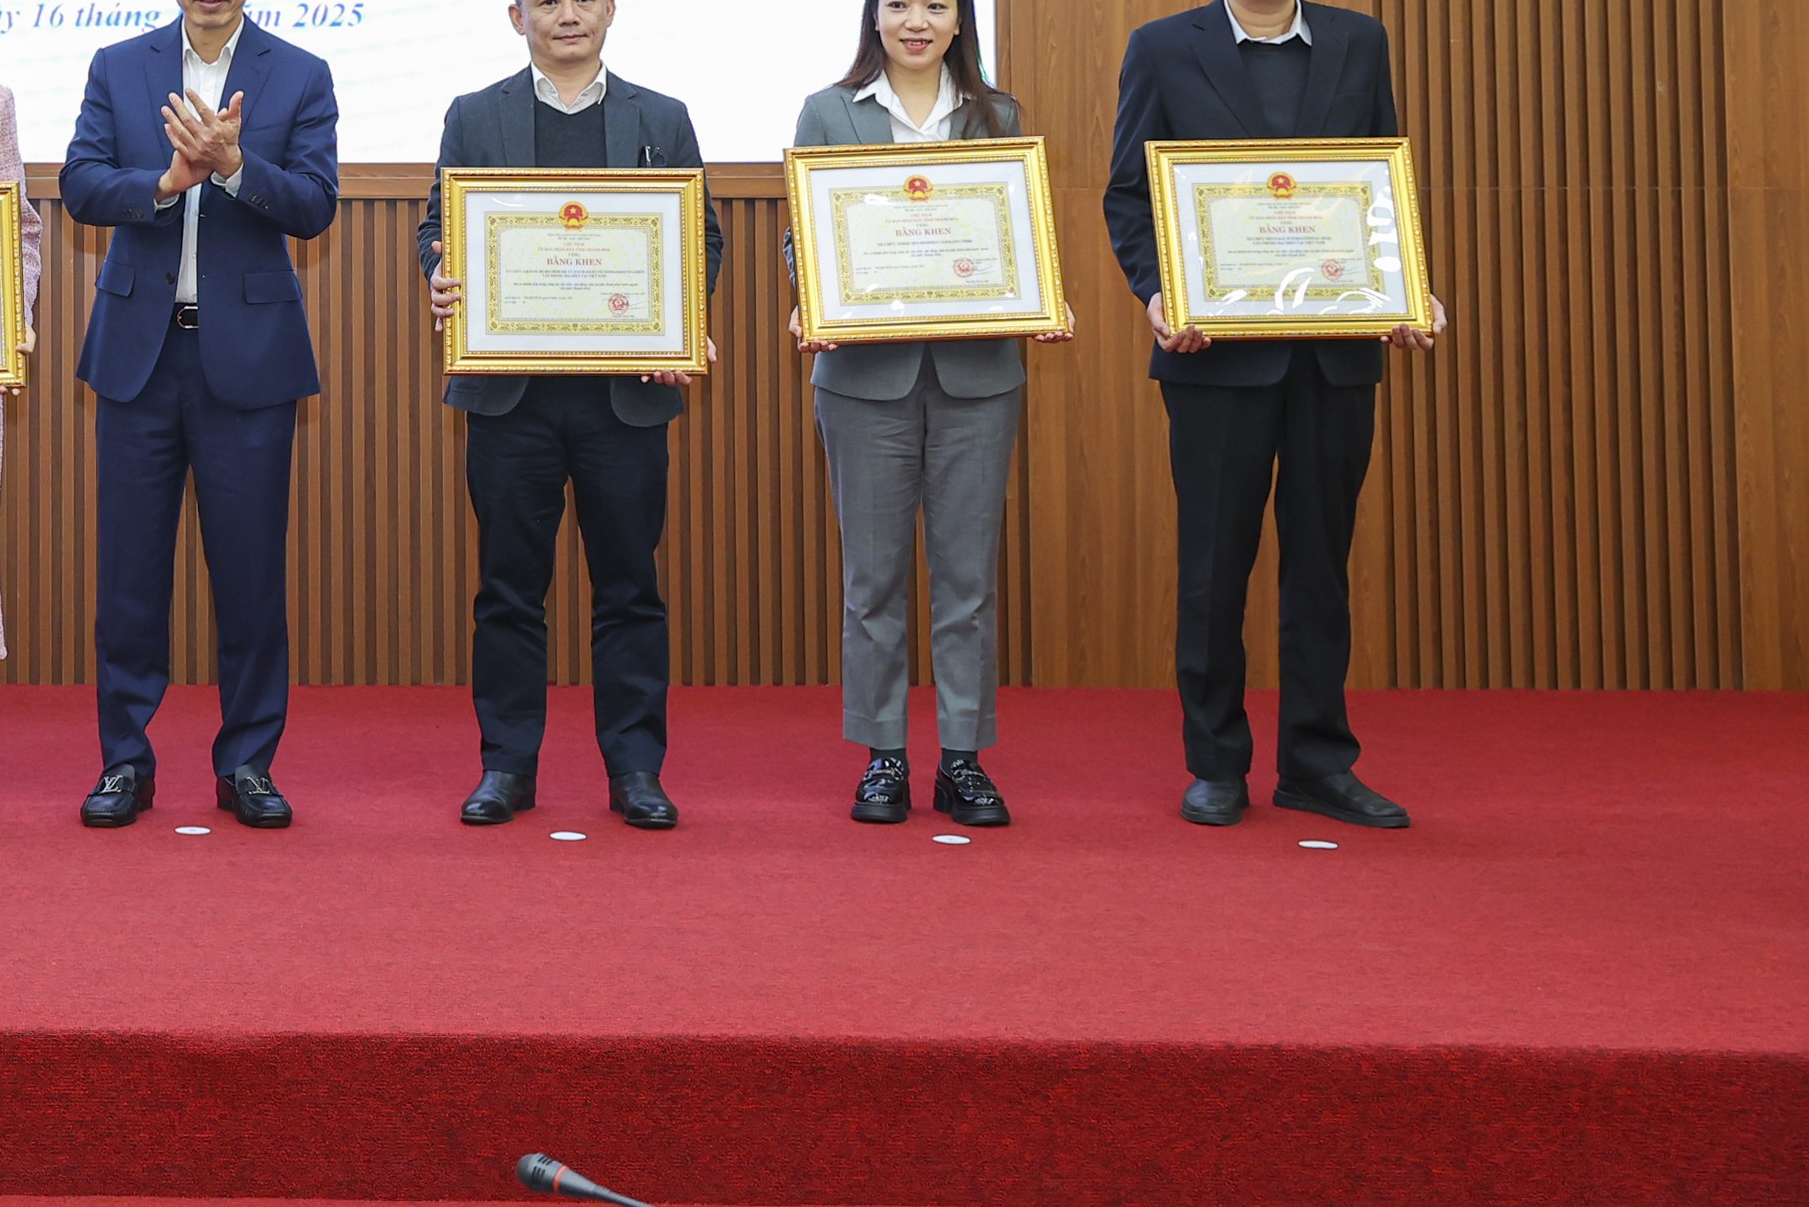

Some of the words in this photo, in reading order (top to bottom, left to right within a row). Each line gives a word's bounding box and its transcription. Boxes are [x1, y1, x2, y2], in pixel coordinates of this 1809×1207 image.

[33, 2, 65, 27] 16
[75, 2, 161, 30] tháng
[292, 2, 365, 27] 2025
[923, 226, 952, 236] KHEN
[1288, 224, 1317, 233] KHEN
[575, 257, 603, 266] KHEN
